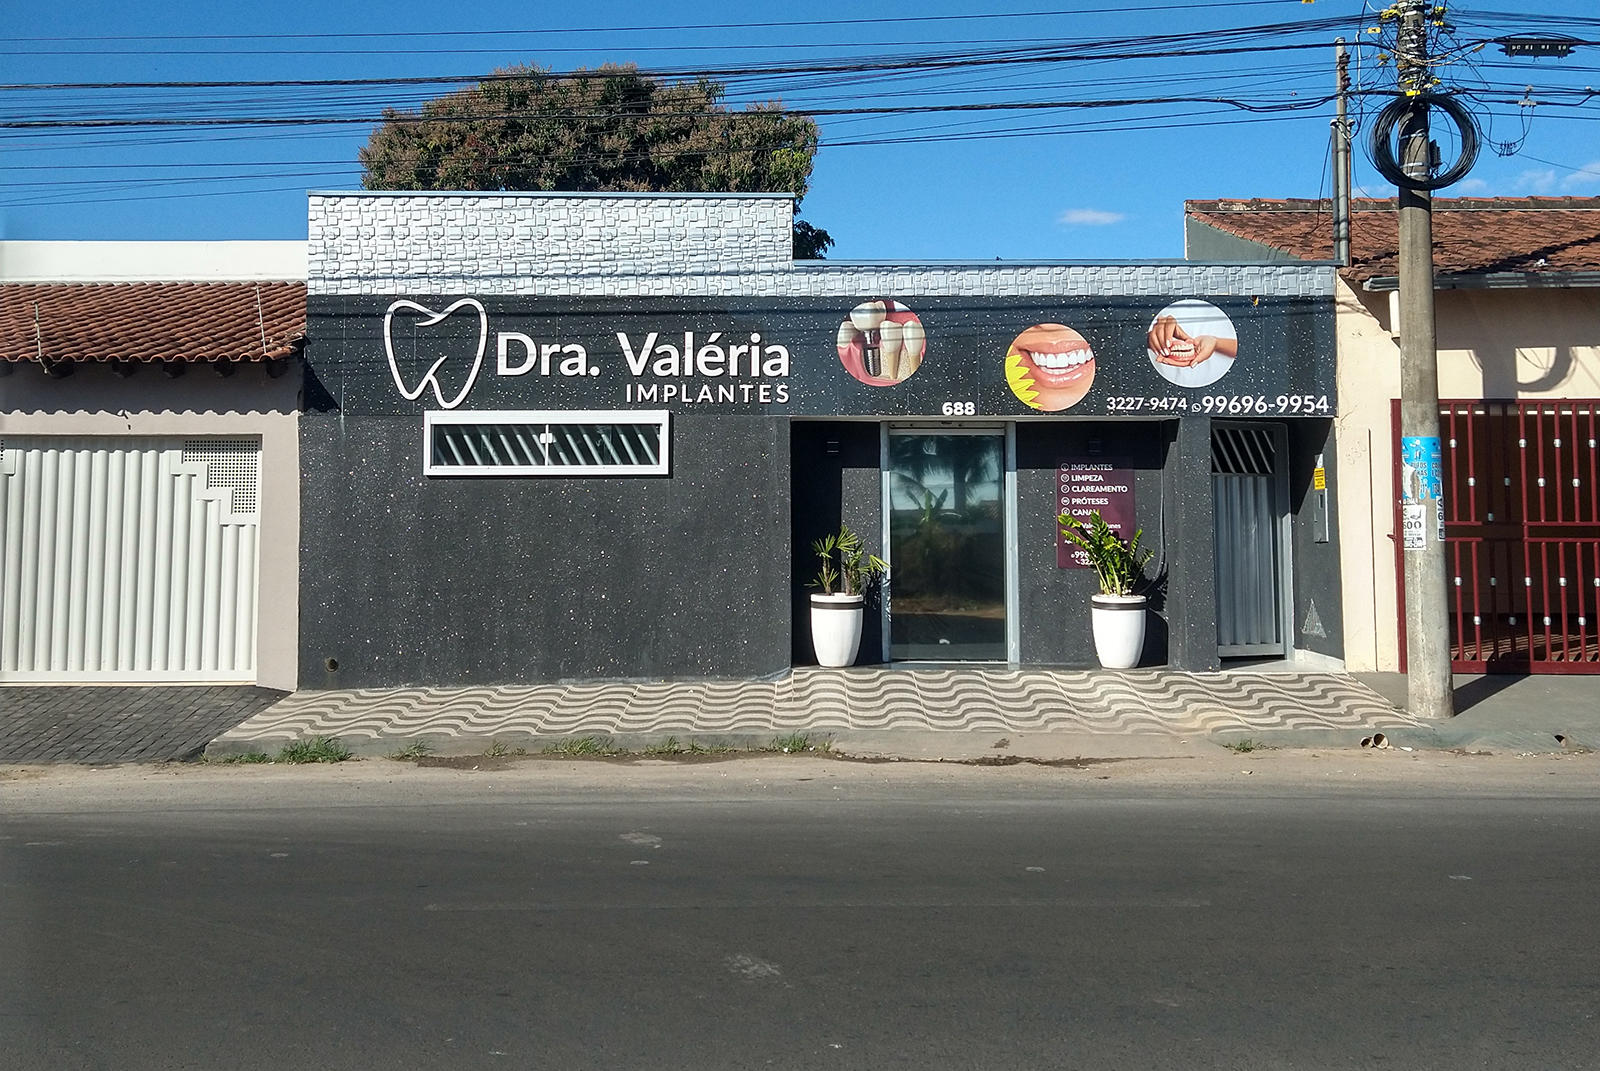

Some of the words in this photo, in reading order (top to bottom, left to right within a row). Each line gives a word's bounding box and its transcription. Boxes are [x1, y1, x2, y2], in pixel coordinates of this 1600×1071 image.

[496, 331, 600, 377] Dra.
[616, 331, 790, 377] Valéria
[626, 384, 790, 404] IMPLANTES
[942, 401, 976, 416] 688
[1106, 397, 1188, 411] 3227-9474
[1201, 395, 1330, 414] 99696-9954
[1071, 463, 1113, 471] IMPLANTES
[1071, 474, 1104, 482] LIMPEZA
[1071, 485, 1128, 493] CLAREAMENTO
[1071, 496, 1109, 505] PRÓTESES
